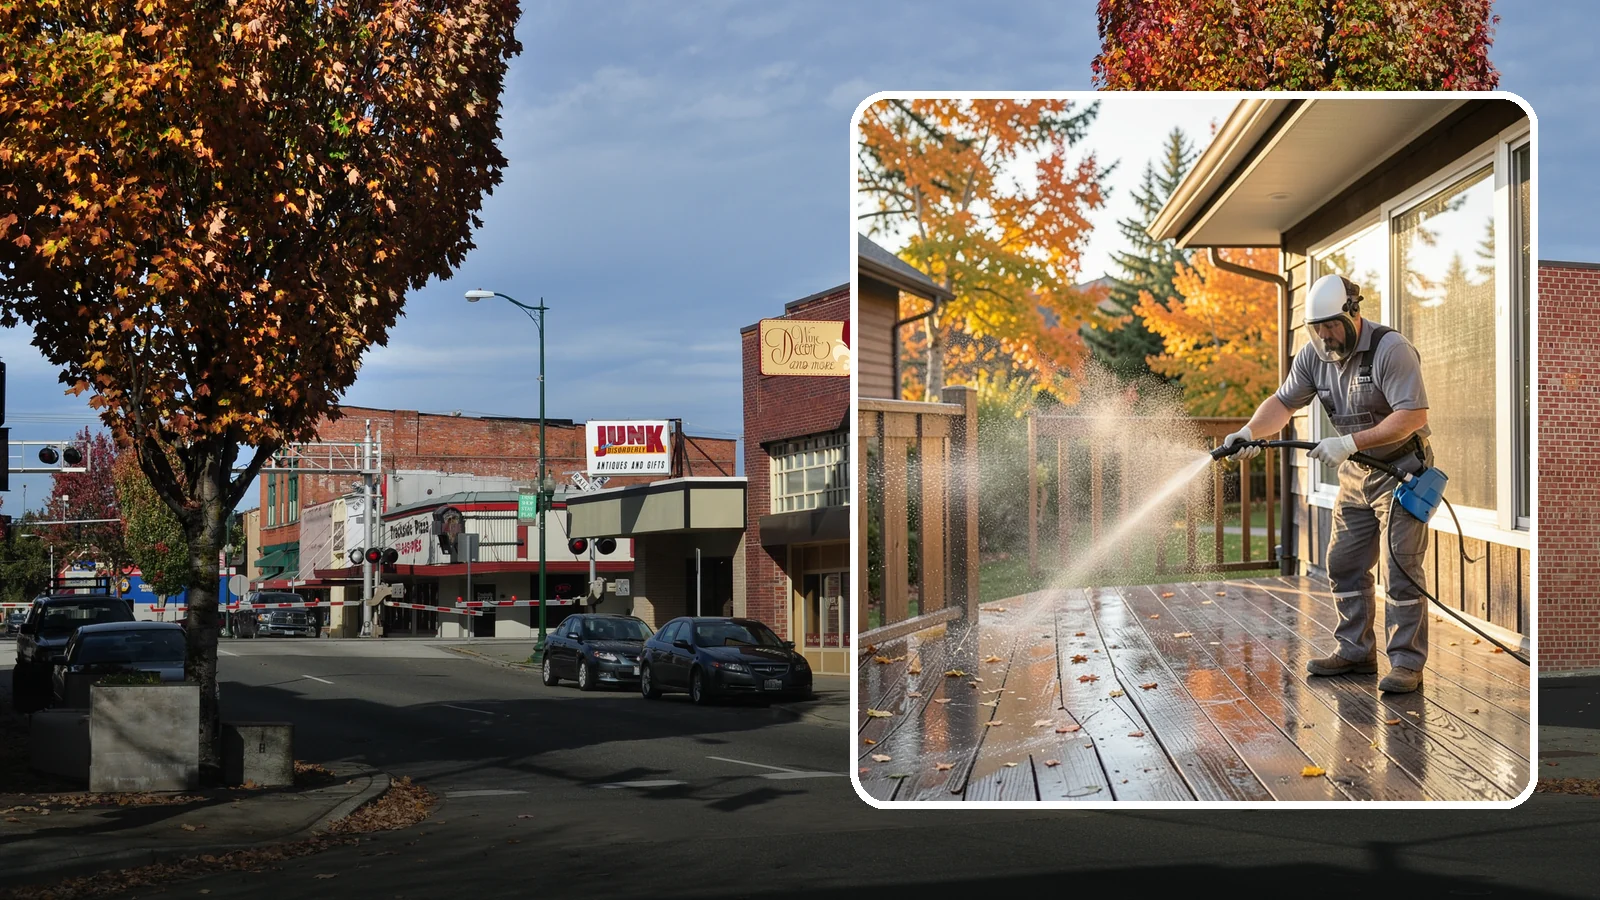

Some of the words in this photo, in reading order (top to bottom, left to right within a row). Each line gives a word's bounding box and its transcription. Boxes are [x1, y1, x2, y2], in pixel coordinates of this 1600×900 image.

[596, 425, 665, 457] JUNK
[607, 446, 646, 454] DISORDERLY
[597, 461, 628, 470] ANTIQUES
[631, 461, 644, 470] AND
[647, 460, 665, 469] GIFTS
[390, 522, 413, 539] Trackside
[414, 519, 429, 534] Pizza
